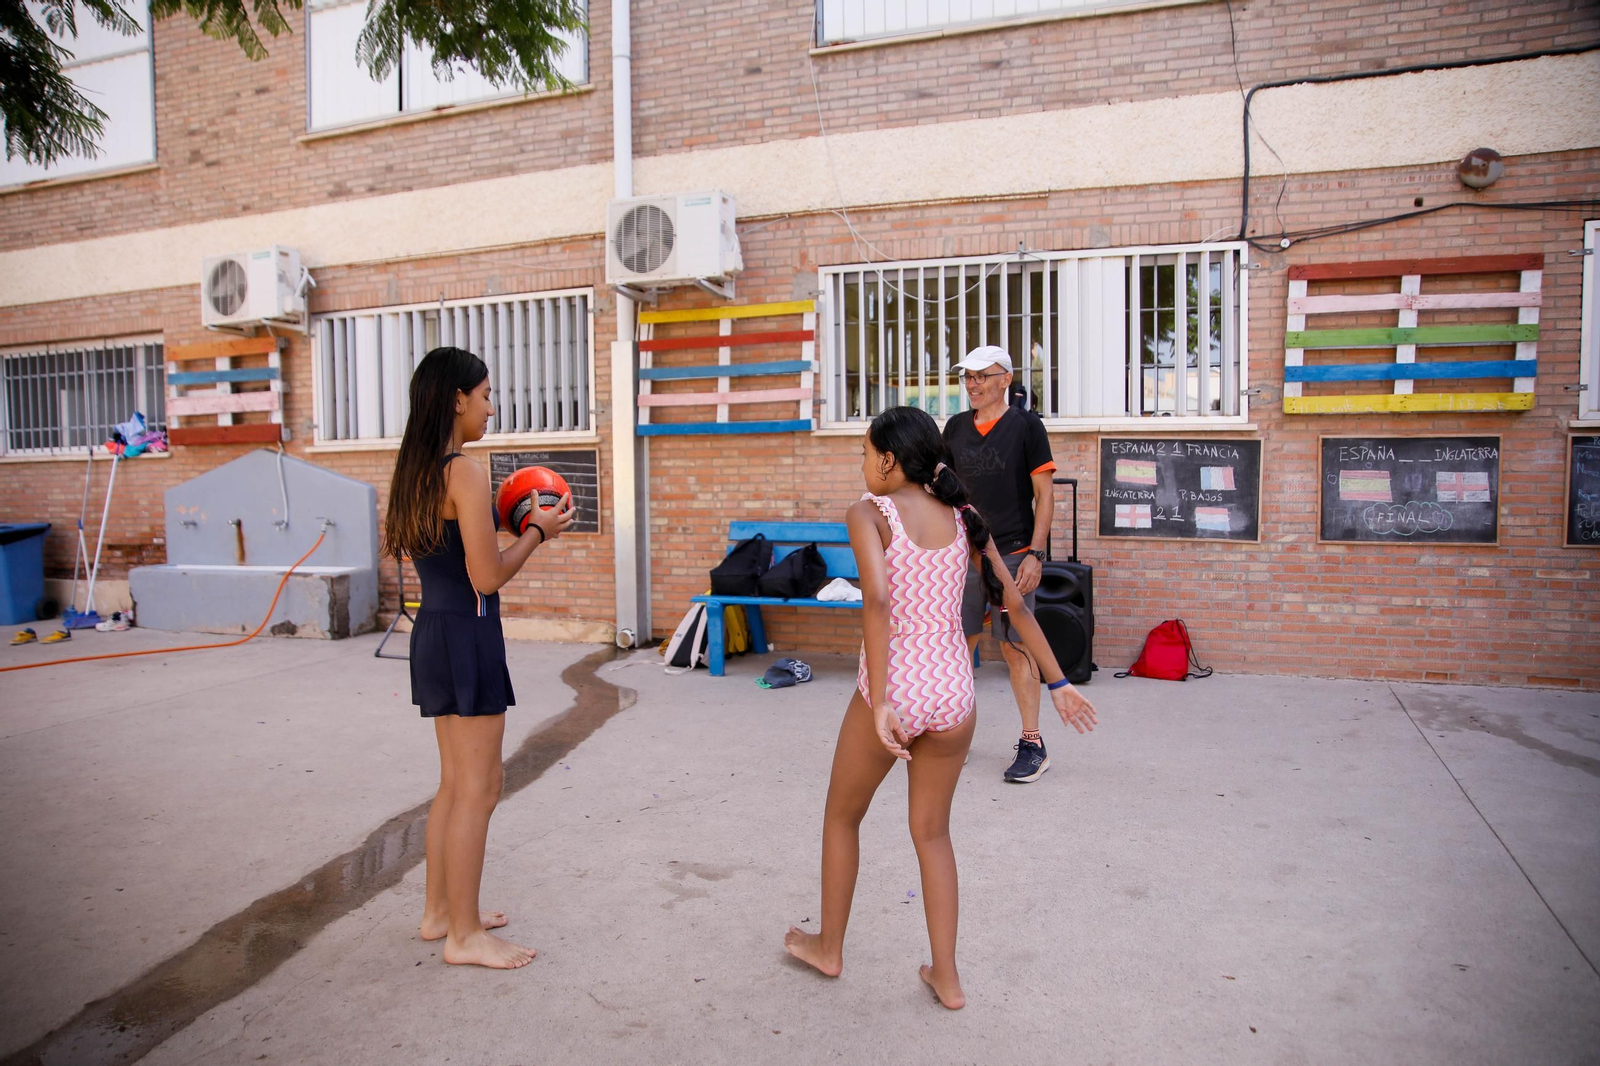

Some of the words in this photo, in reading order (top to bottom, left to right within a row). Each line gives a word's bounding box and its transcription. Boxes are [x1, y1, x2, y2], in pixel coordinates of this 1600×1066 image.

[1110, 441, 1155, 454] ESPAÑA
[1156, 441, 1166, 454] 2
[1171, 441, 1183, 454] 1
[1186, 443, 1239, 459] FRANCIA
[1339, 445, 1395, 461] ESPAÑA
[1434, 447, 1498, 462] INGLATERRA
[1104, 488, 1156, 500] INGLATERRA
[1191, 491, 1223, 502] BAJOS
[1156, 506, 1166, 518] 2
[1172, 506, 1182, 518] 1
[1377, 511, 1430, 524] FINAL
